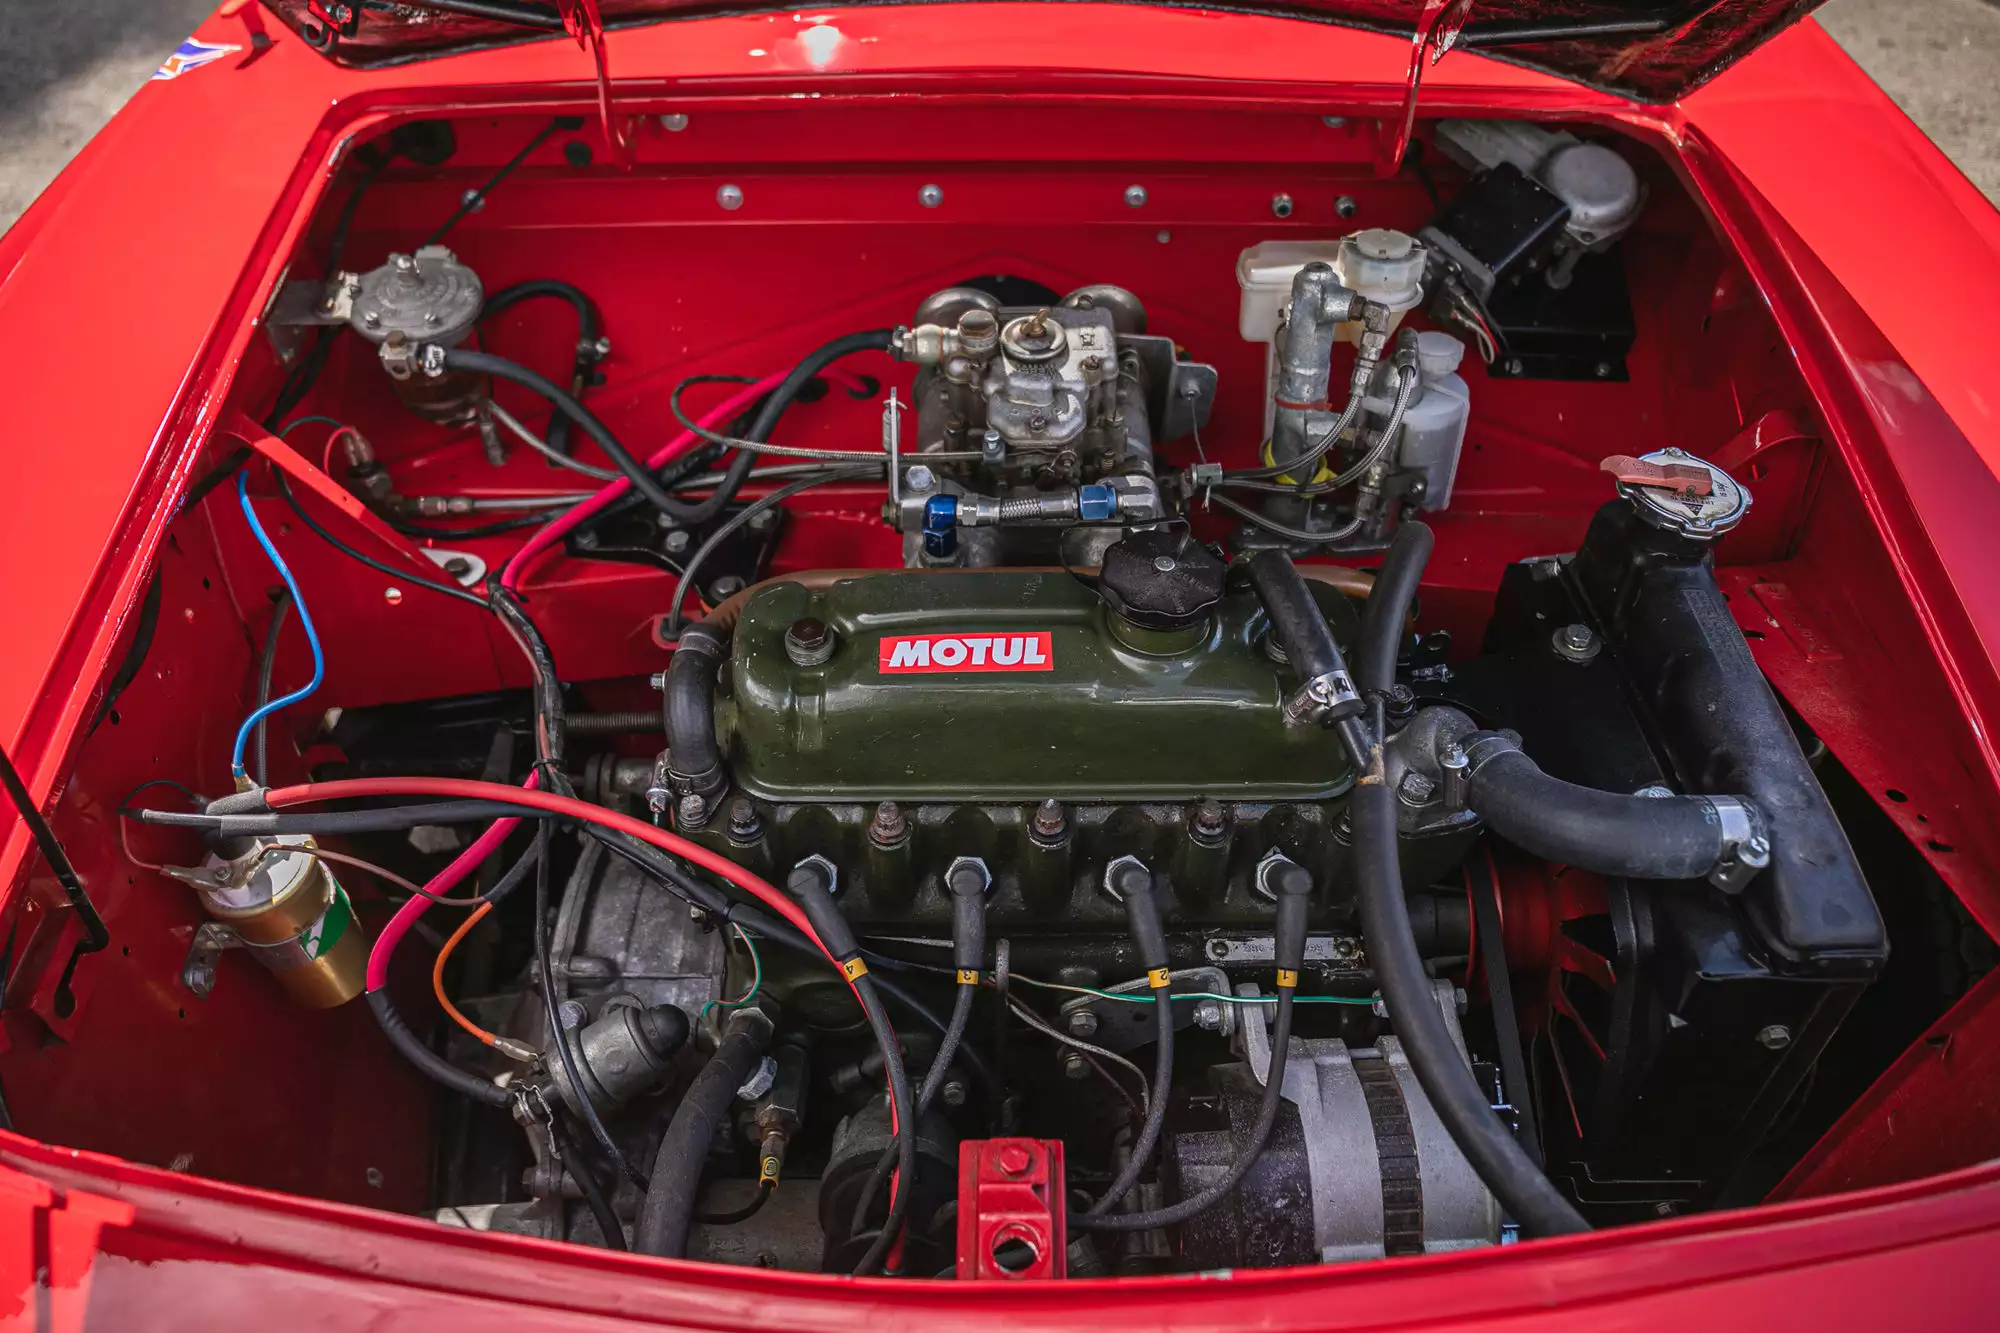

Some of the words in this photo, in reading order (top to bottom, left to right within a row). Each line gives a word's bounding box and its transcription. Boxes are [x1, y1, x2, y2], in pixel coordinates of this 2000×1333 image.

[888, 637, 1046, 667] MOTUL
[845, 965, 854, 975] 4
[963, 970, 972, 980] 3
[1160, 969, 1168, 980] 2
[1283, 968, 1289, 980] 1
